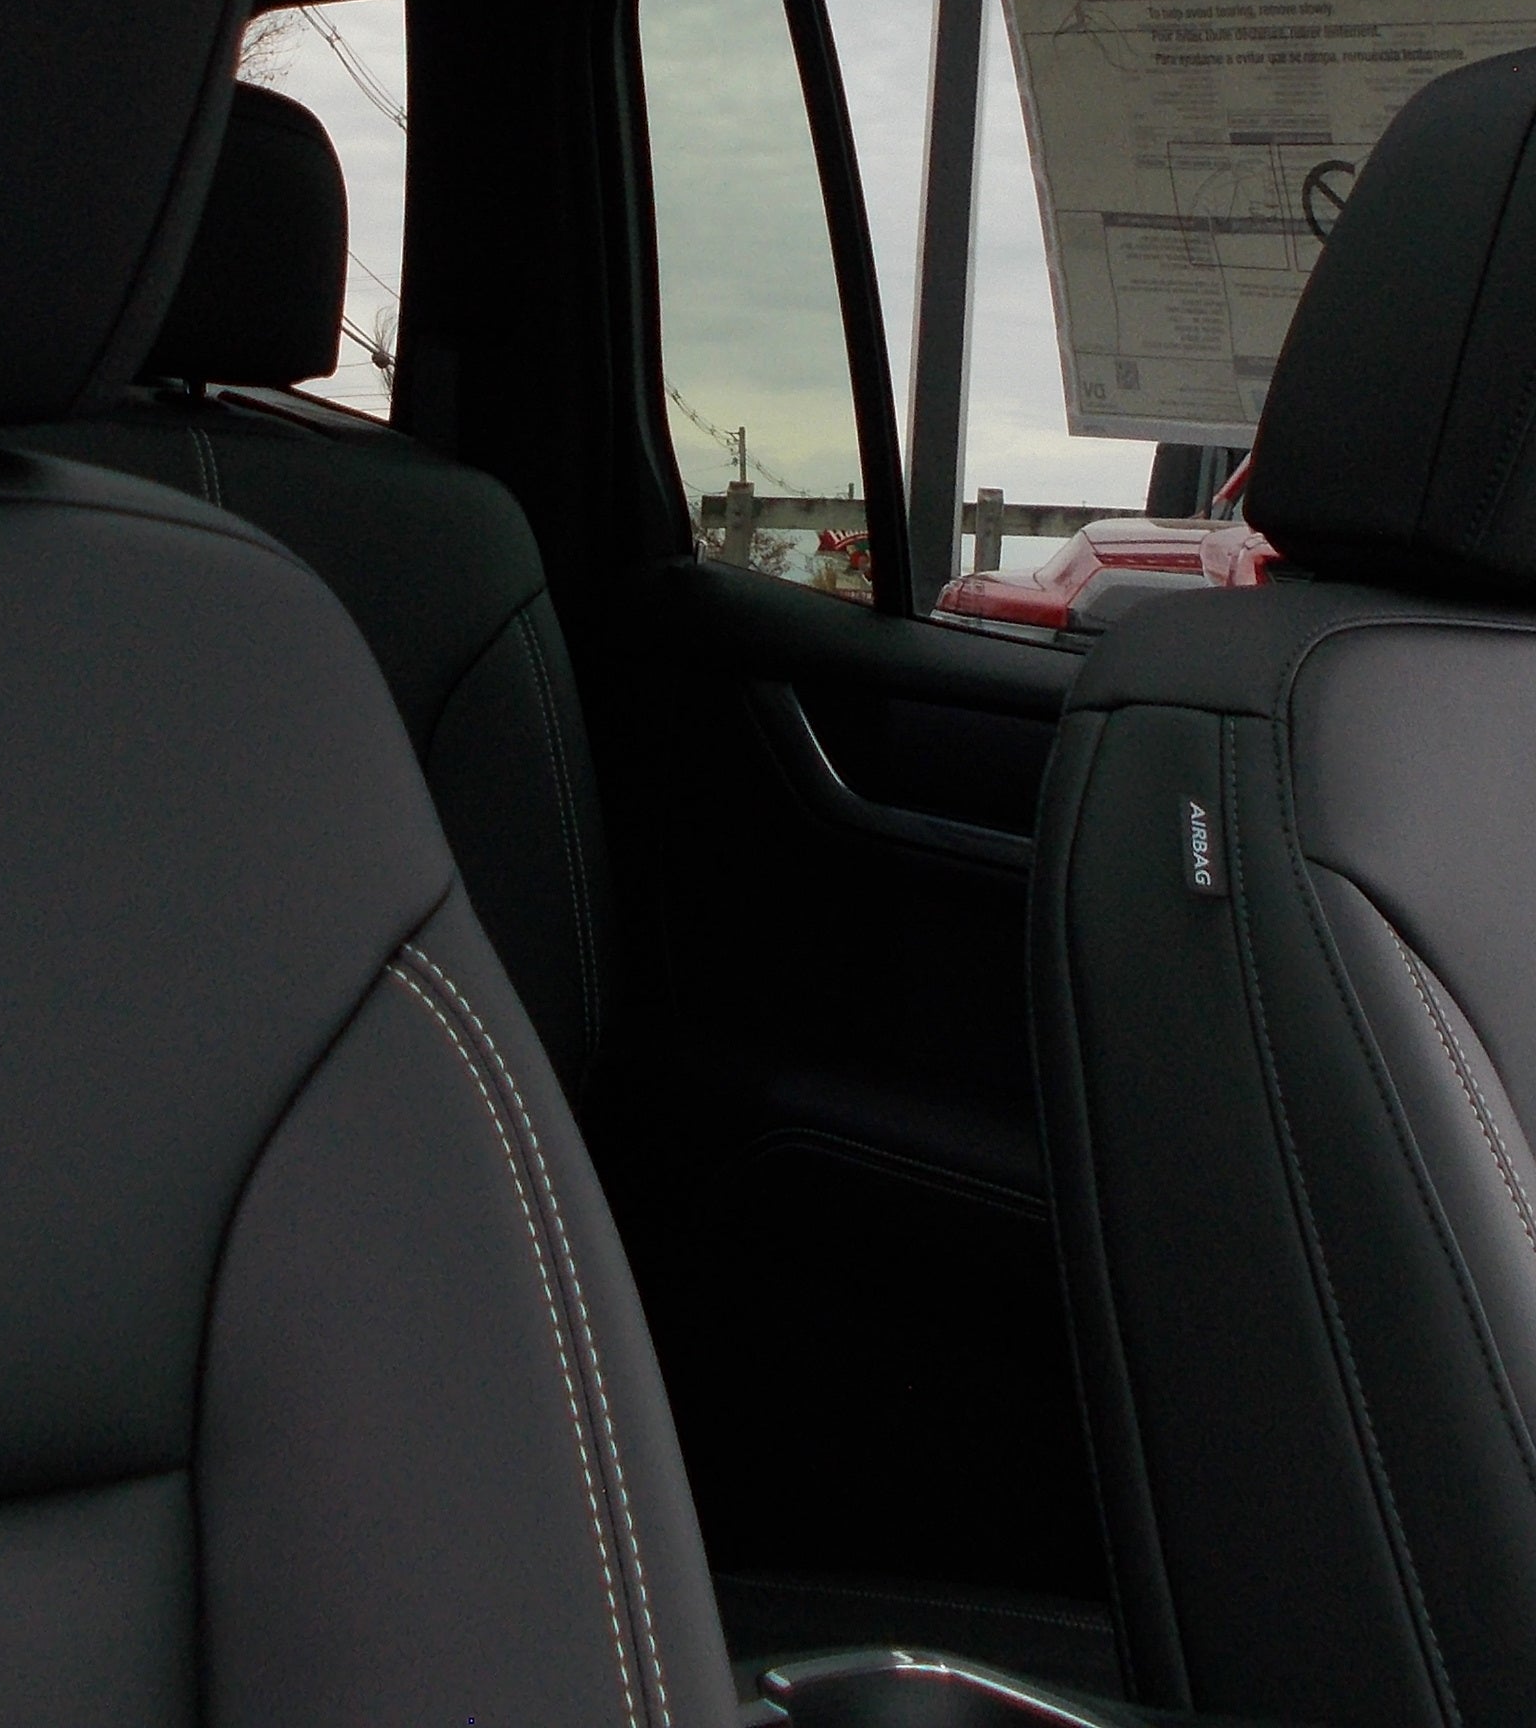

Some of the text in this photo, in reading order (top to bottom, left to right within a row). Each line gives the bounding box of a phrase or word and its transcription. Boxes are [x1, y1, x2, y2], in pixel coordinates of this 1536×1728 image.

[1148, 6, 1161, 19] To
[1185, 5, 1213, 18] avoid
[1259, 3, 1297, 16] remove
[1189, 801, 1212, 887] AIRBAG
